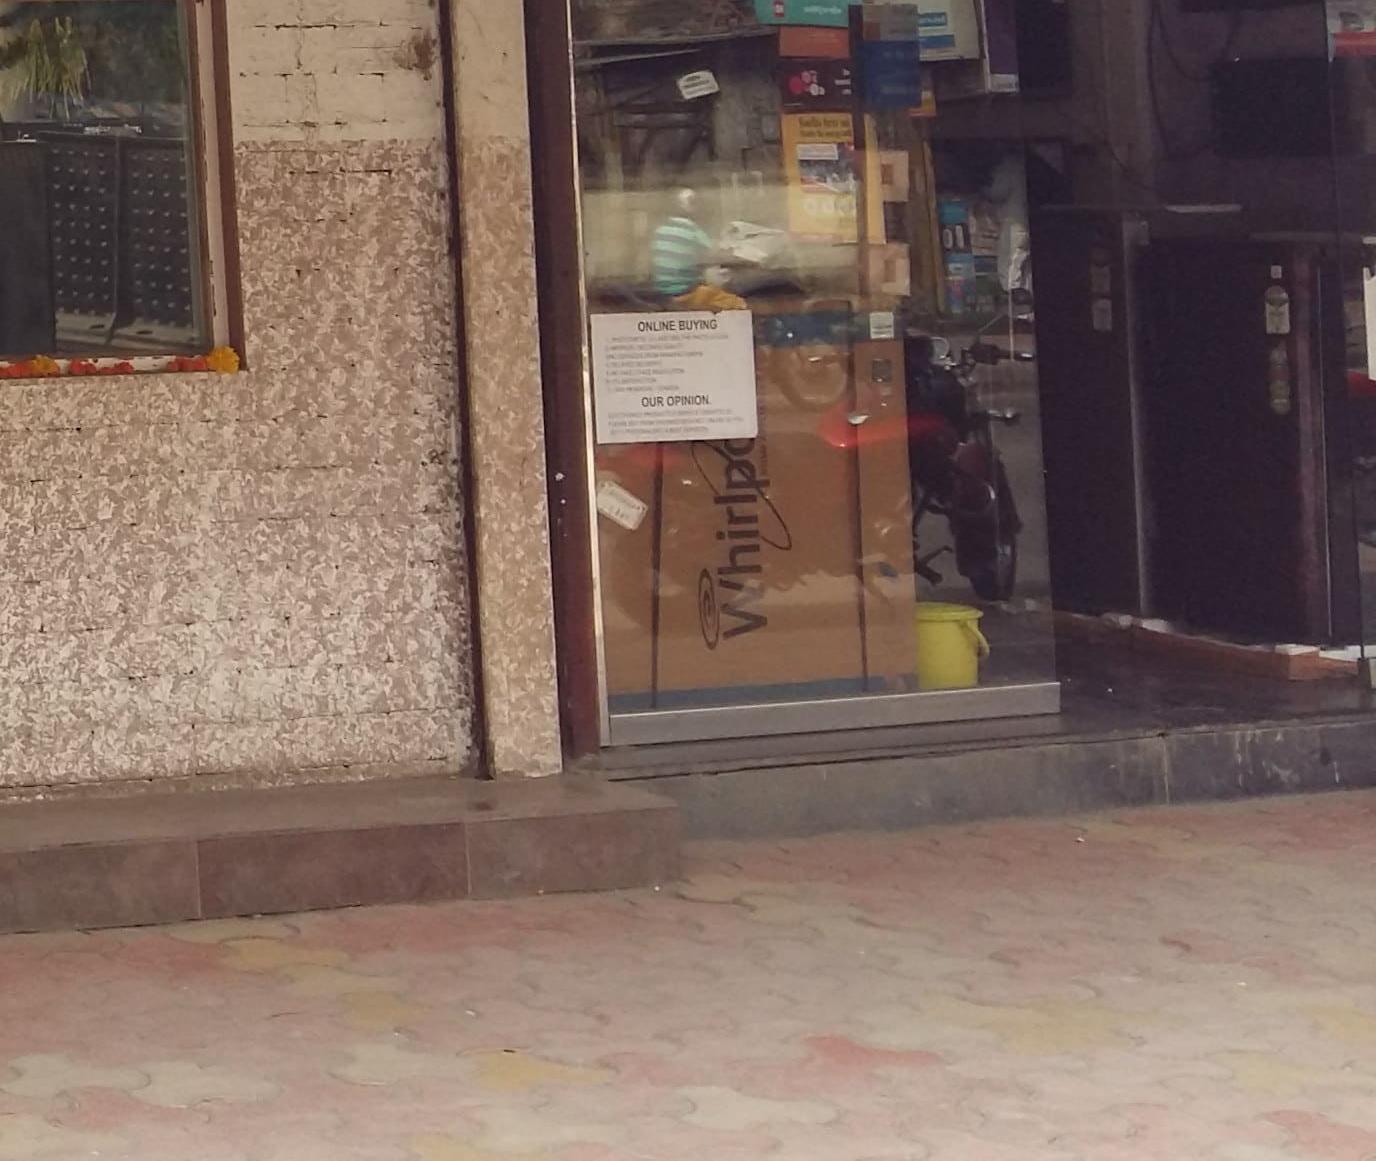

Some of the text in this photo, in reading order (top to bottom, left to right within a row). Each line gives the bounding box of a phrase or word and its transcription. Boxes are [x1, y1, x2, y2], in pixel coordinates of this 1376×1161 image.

[637, 319, 718, 332] ONLINE BUYING
[641, 396, 664, 408] OUR
